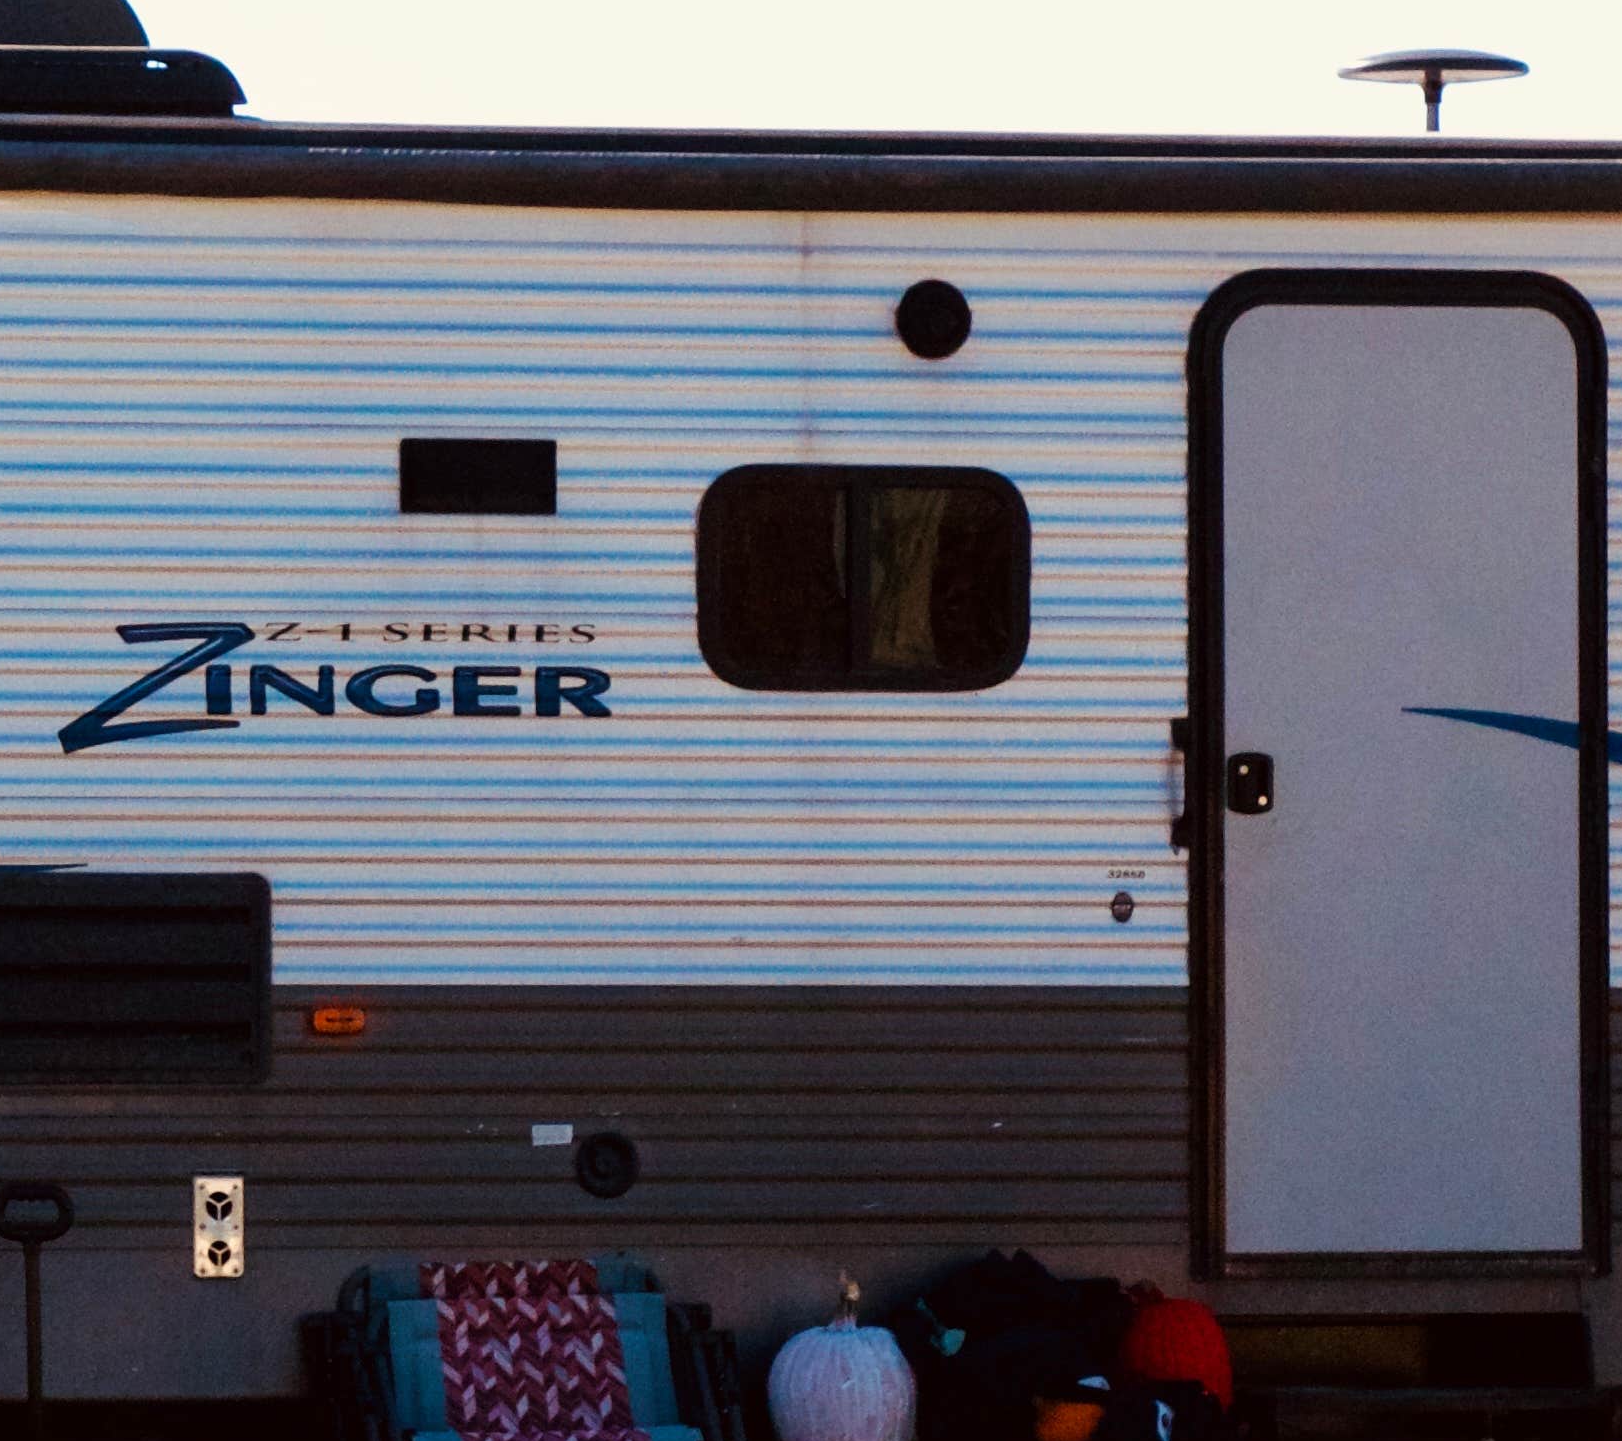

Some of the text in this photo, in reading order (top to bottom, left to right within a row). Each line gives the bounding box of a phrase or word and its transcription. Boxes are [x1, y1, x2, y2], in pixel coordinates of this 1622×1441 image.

[265, 621, 597, 645] Z-1 SERIES
[57, 621, 612, 755] ZINGER
